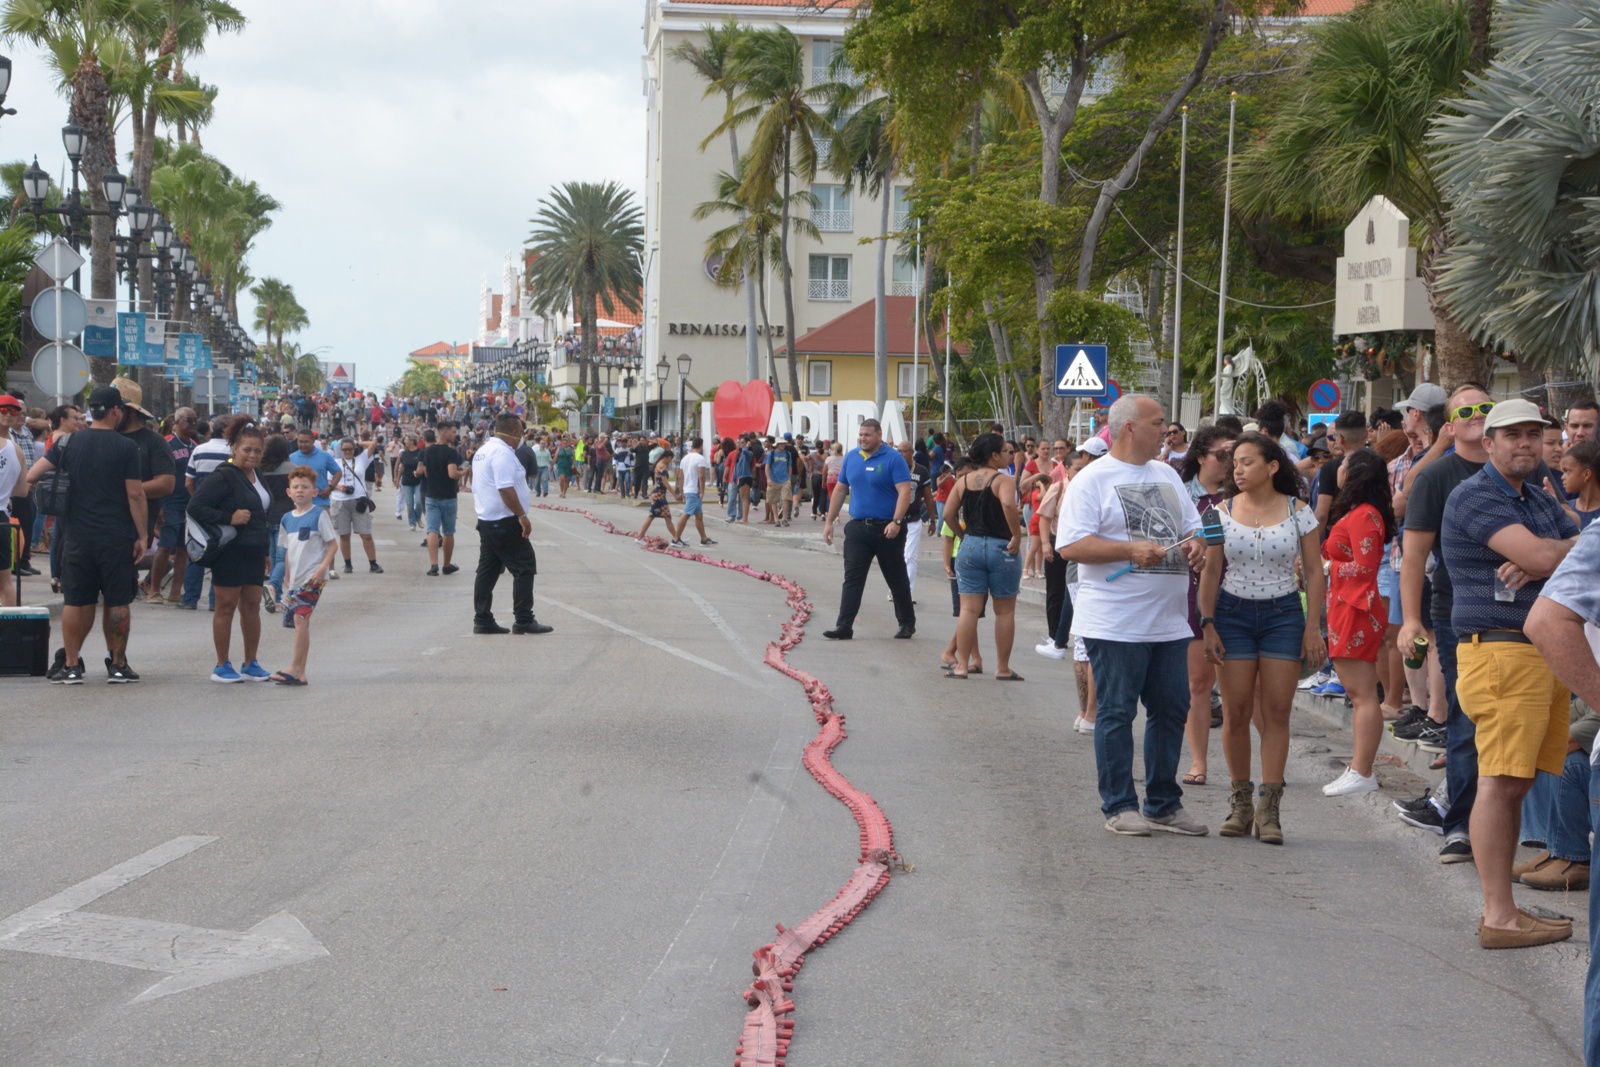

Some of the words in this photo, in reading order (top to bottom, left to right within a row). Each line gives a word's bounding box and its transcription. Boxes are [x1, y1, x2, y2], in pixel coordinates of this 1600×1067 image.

[125, 317, 137, 326] THE
[124, 325, 139, 334] NEW
[124, 334, 138, 343] WAY
[127, 343, 136, 351] TO
[124, 352, 140, 360] PLAY
